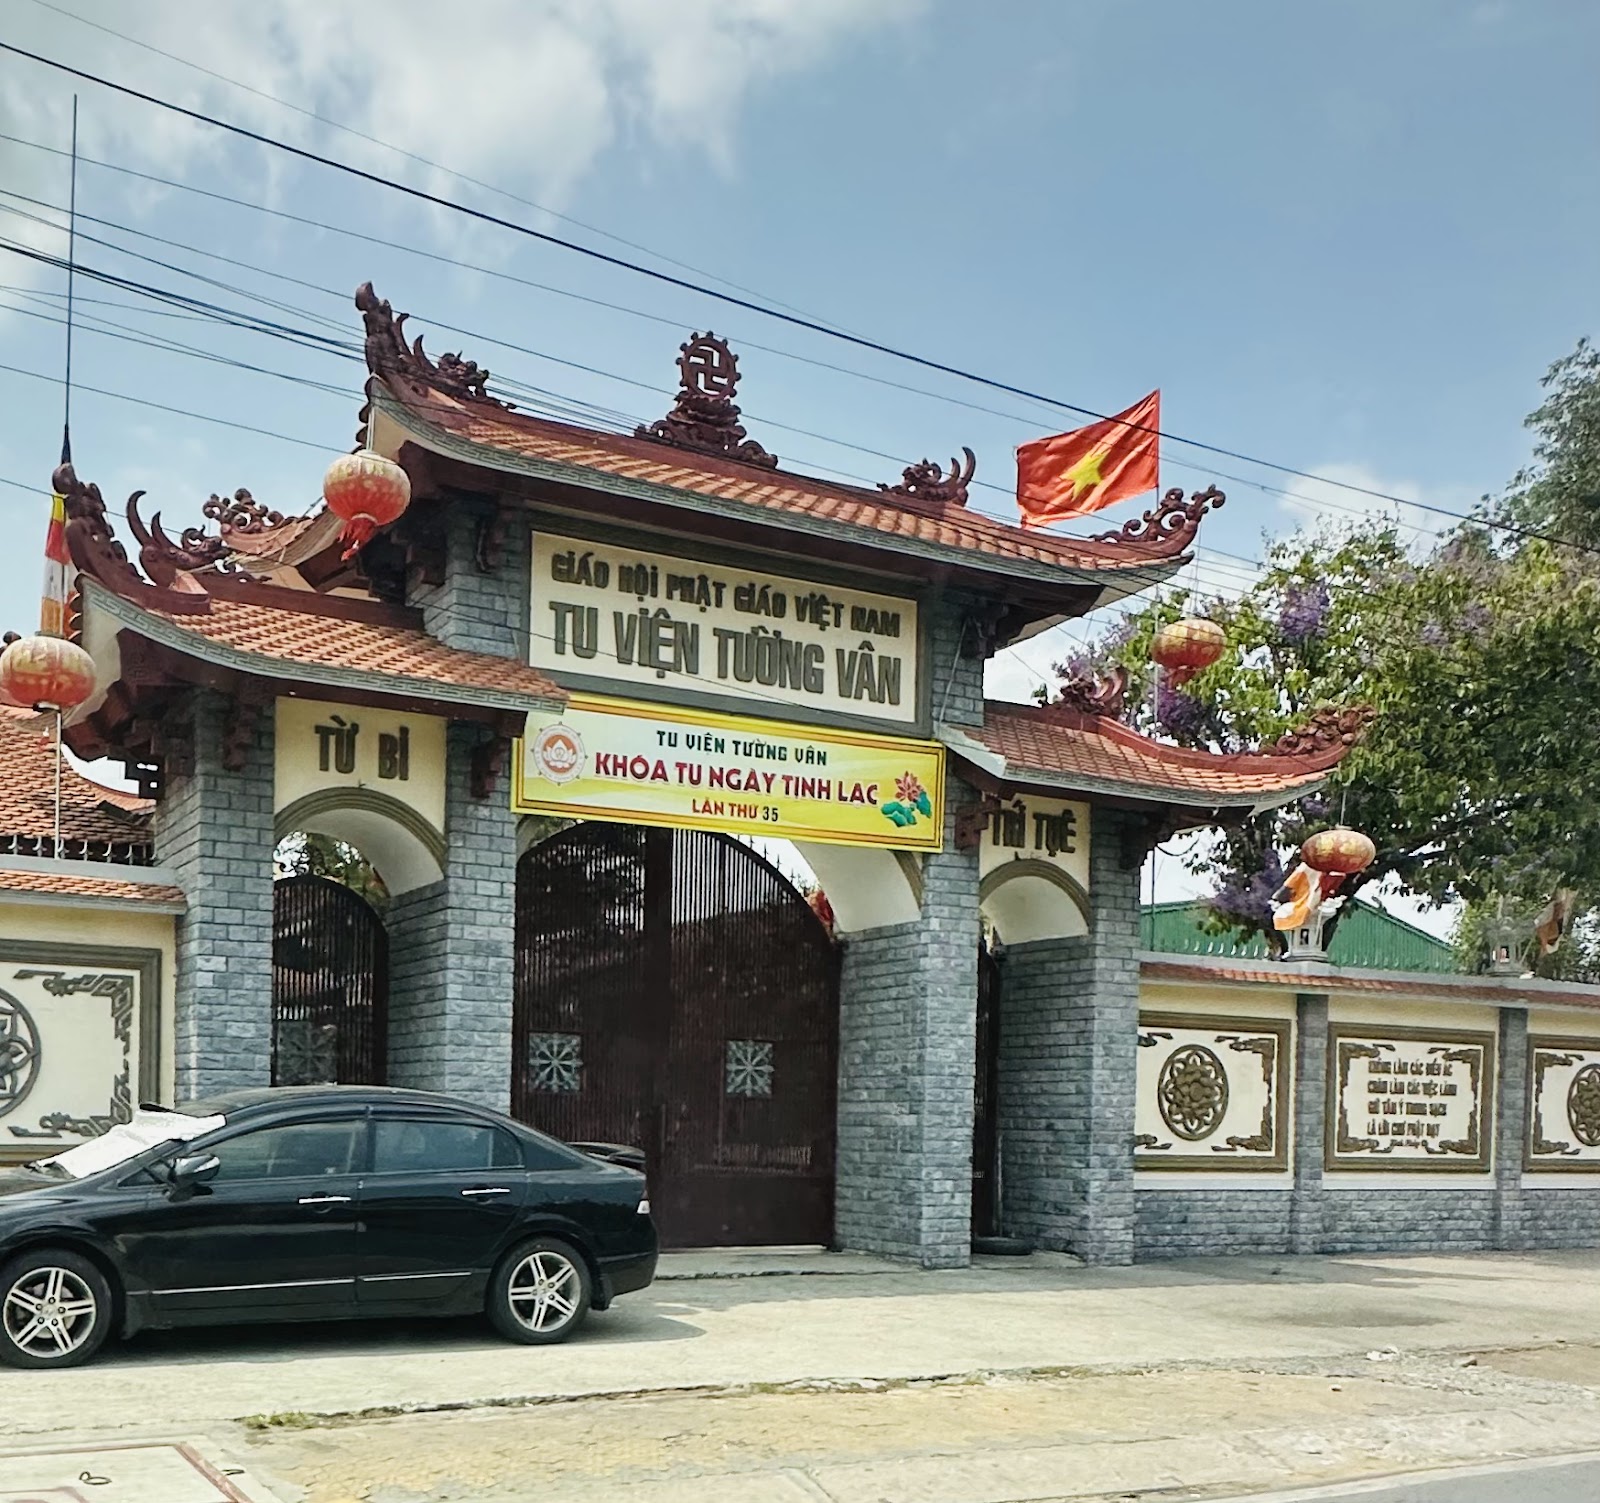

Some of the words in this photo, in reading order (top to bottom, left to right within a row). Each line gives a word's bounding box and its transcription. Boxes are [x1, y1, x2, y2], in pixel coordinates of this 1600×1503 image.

[552, 551, 610, 590] GIÁO
[618, 563, 659, 602] HỘI
[666, 574, 727, 613] PHẬT
[734, 582, 787, 619] GIÁO
[794, 592, 845, 631] VIỆT
[851, 605, 901, 638] NAM
[549, 601, 599, 659] TU
[613, 607, 699, 679] VIỆN
[713, 625, 824, 694] TƯỜNG
[835, 640, 902, 706] VÂN
[314, 715, 360, 774] TỪ
[378, 726, 410, 781] BI
[595, 752, 669, 783] KHÓA
[675, 762, 702, 787] TU
[709, 765, 777, 794] NGÀY
[657, 730, 678, 748] TU
[686, 732, 725, 755] VIỆN
[732, 738, 788, 762] TƯỜNG
[794, 744, 828, 766] VÂN
[692, 797, 725, 816] LẦN
[762, 806, 779, 823] 35
[987, 799, 1026, 848] TRÍ
[1033, 808, 1077, 857] TUỆ
